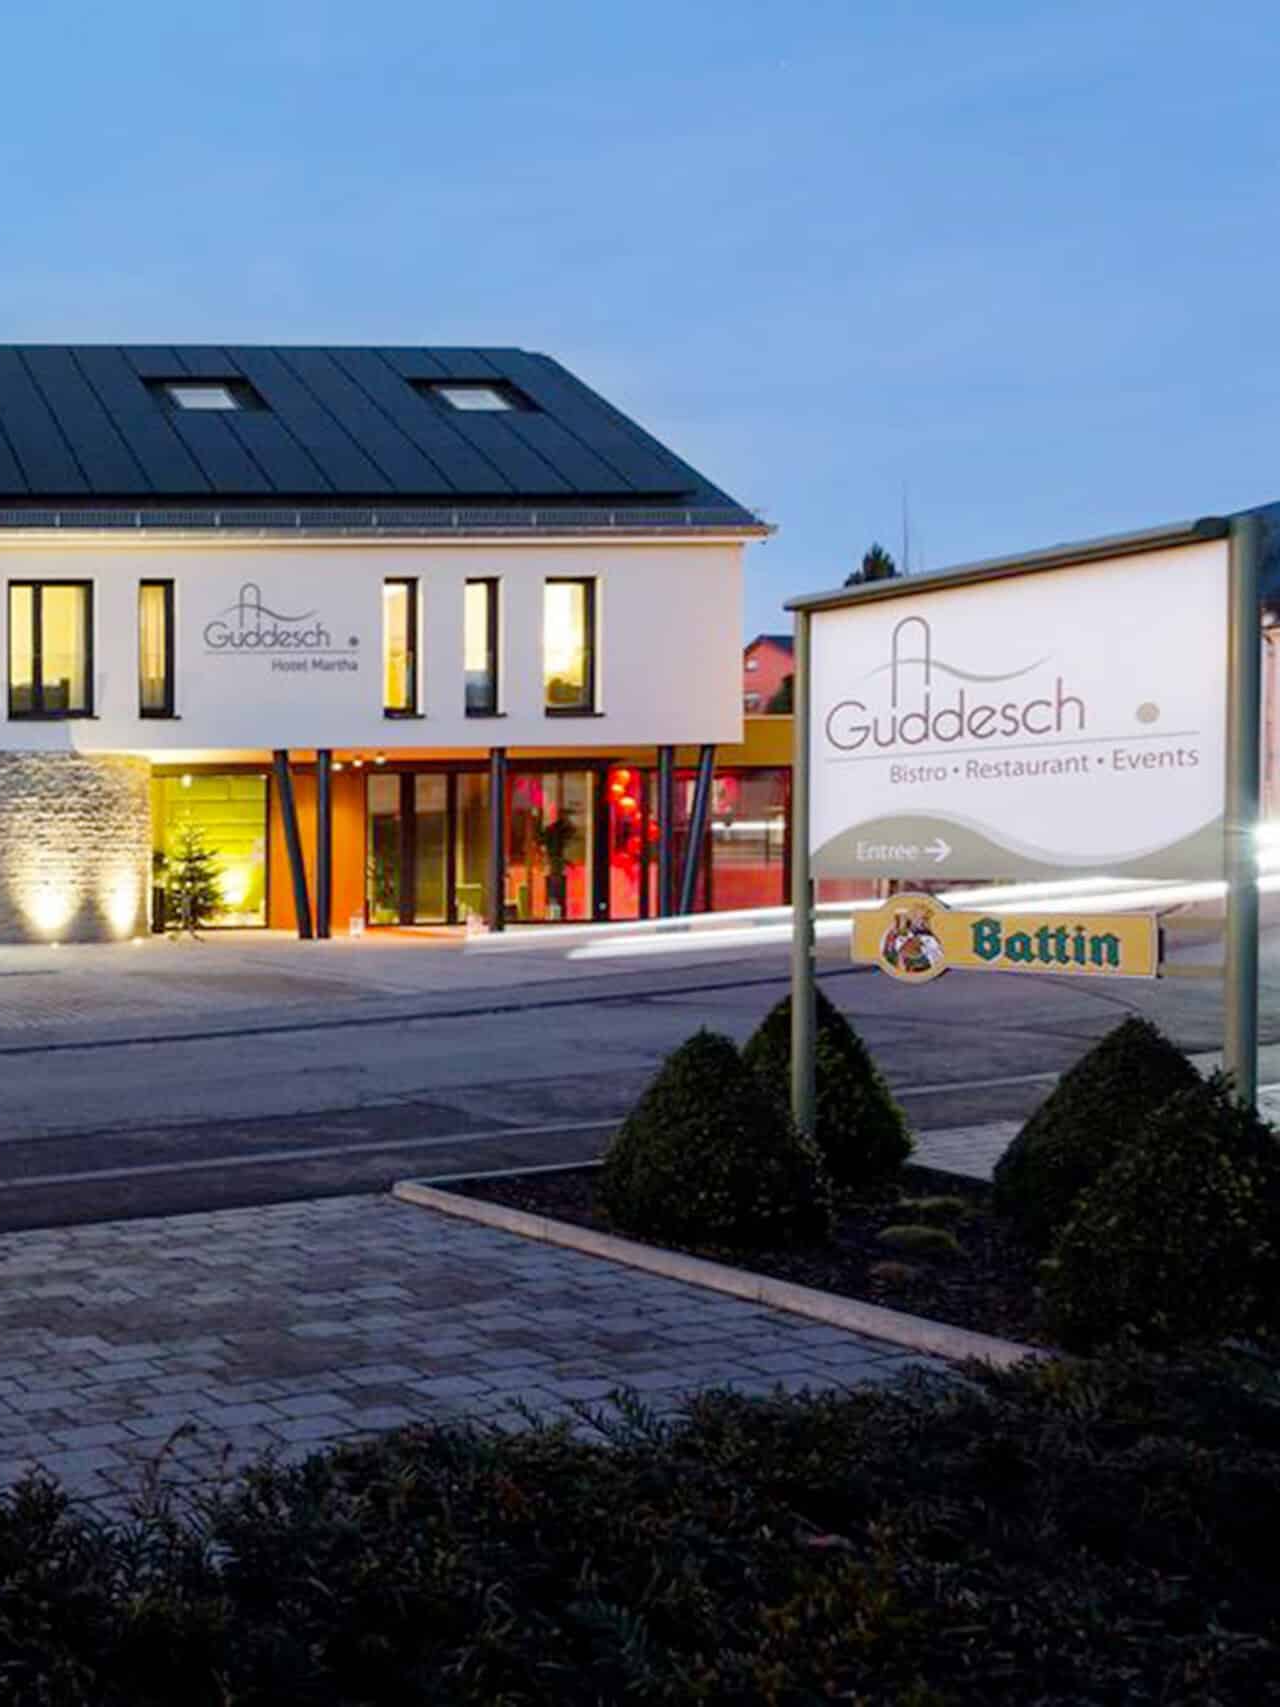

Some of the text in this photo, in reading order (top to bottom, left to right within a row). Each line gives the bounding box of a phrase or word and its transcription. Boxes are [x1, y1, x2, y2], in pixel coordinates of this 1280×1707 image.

[203, 621, 331, 649] Guddesch
[271, 658, 359, 672] Hotel Martha
[824, 676, 1086, 750] Guddesch
[889, 747, 1200, 784] Bistro Restaurant Events
[970, 916, 1121, 967] Battin
